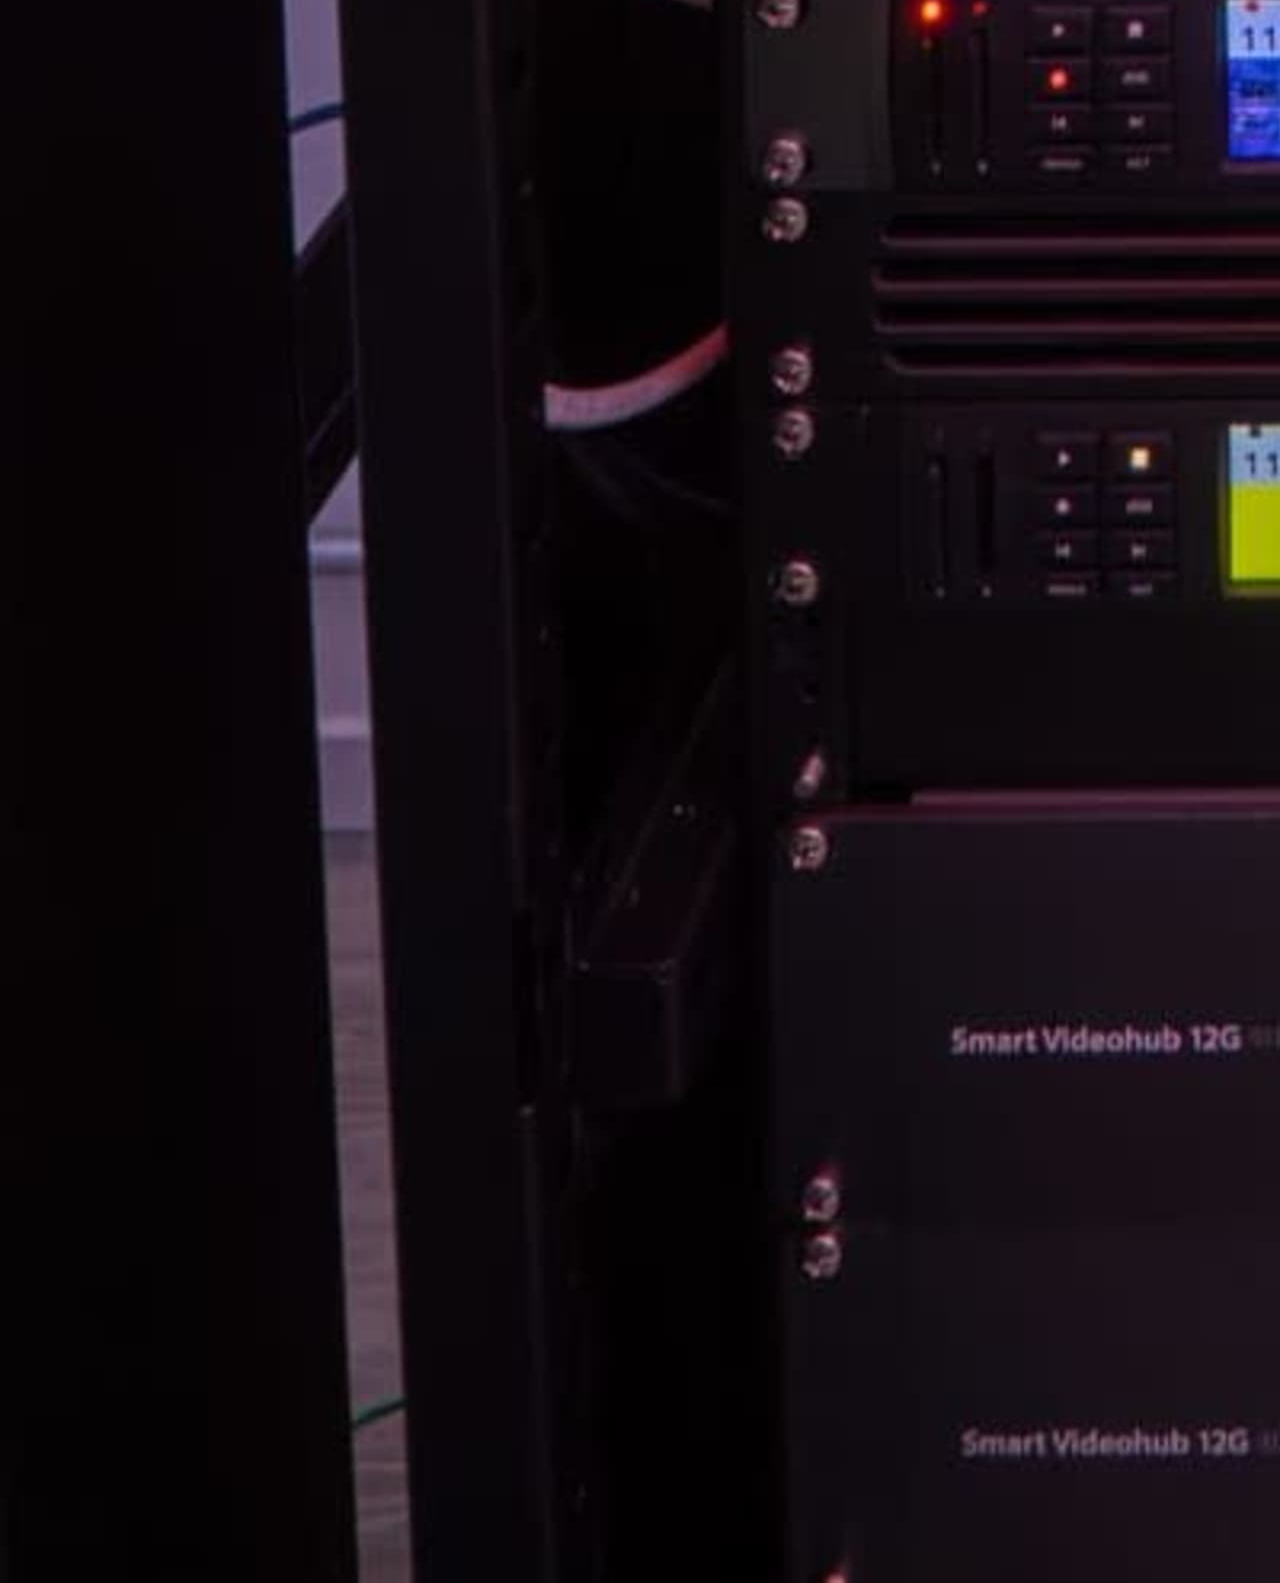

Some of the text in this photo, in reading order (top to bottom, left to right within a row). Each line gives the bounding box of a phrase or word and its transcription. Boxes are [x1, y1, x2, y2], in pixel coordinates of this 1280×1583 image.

[950, 1023, 1242, 1055] Smart Videohub 12G
[960, 1427, 1251, 1458] Smart Videohub 12G
